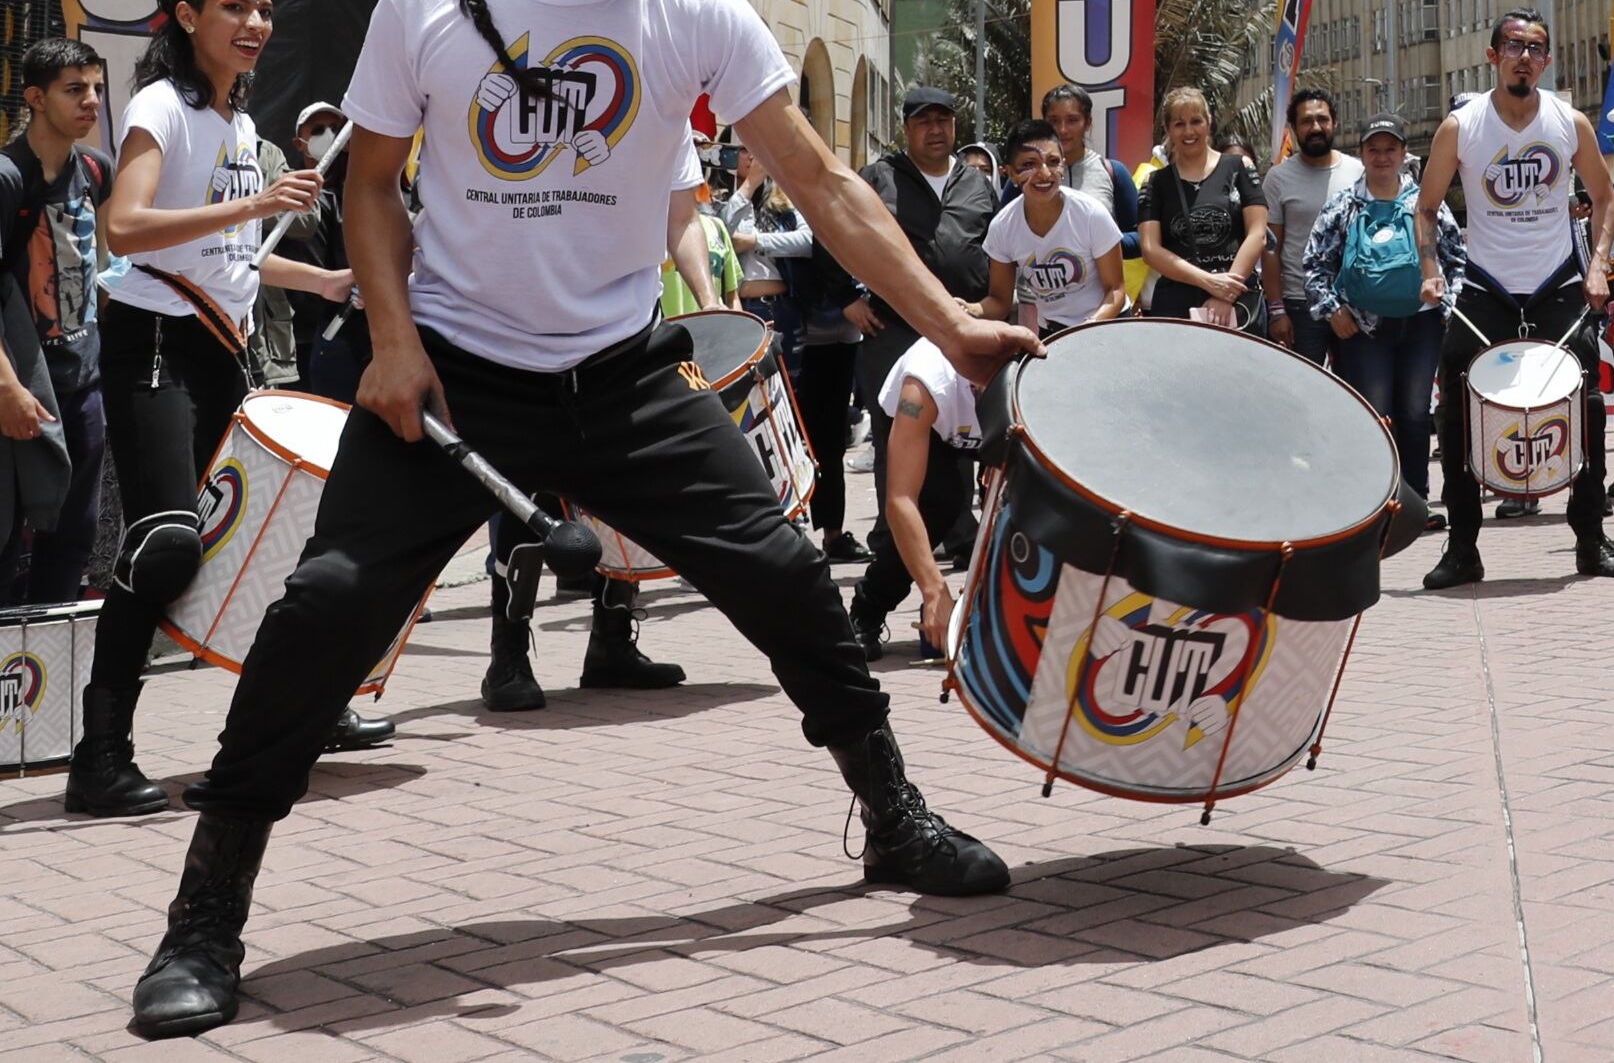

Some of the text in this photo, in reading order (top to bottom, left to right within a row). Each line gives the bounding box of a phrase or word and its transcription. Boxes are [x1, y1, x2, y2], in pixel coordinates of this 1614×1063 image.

[509, 66, 597, 144] CUT
[1501, 158, 1541, 193] CUT
[466, 188, 617, 206] CENTRAL UNITARIA DE TRABAJADORES
[513, 204, 562, 219] DE COLOMBIA
[201, 246, 224, 258] CENTRA
[1033, 264, 1067, 290] CUT
[1512, 436, 1553, 473] CUT
[1112, 624, 1227, 715] CUT
